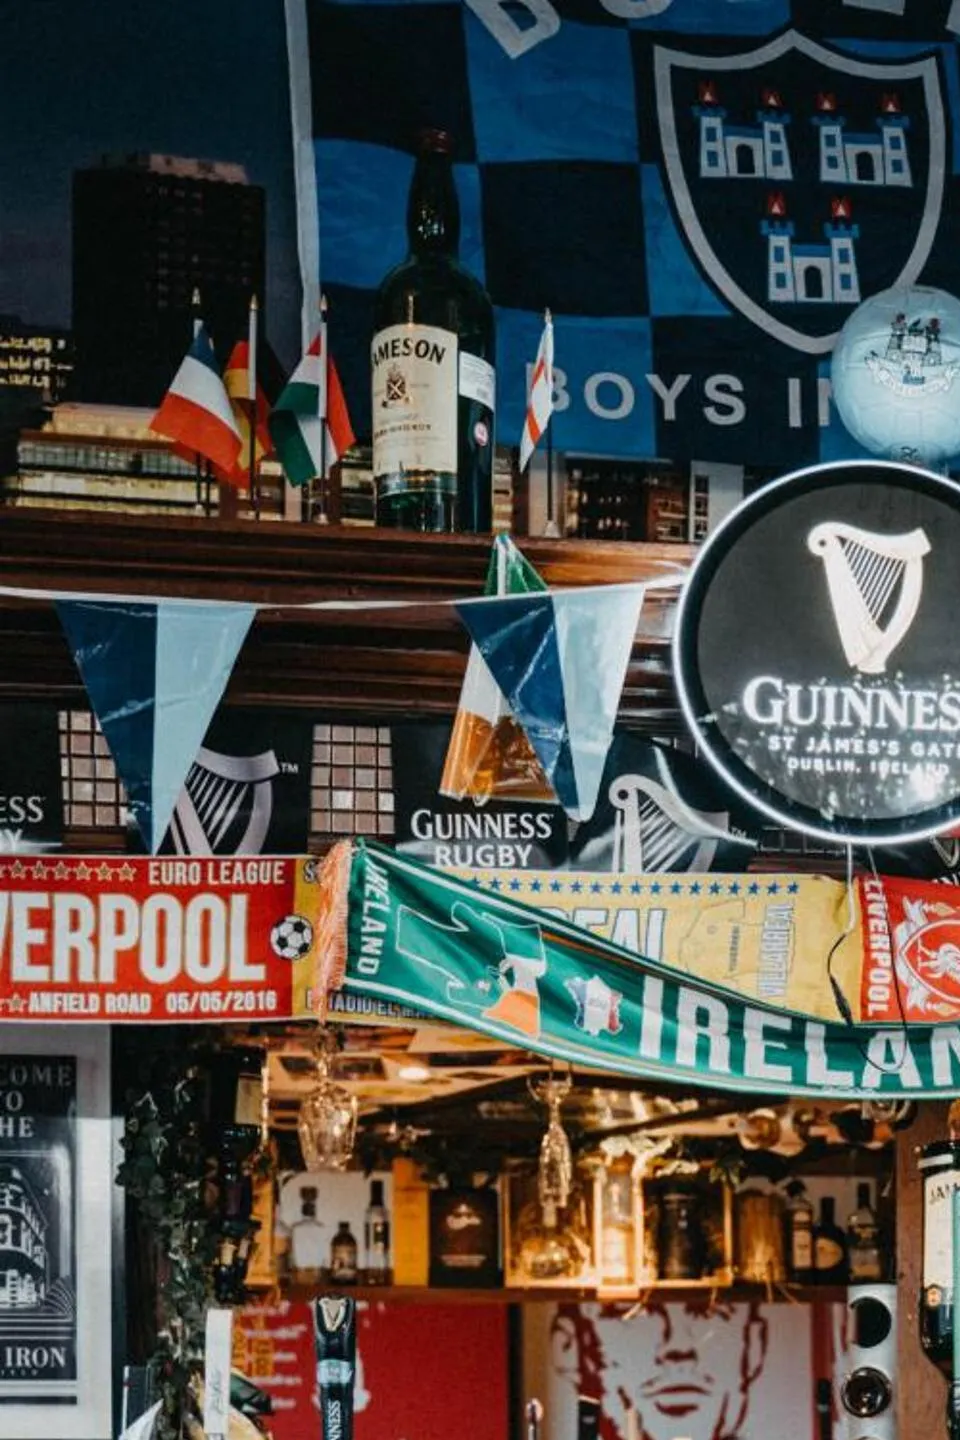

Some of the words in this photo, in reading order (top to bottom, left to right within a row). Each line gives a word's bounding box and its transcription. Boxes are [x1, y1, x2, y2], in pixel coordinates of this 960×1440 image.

[768, 735, 795, 751] ST
[806, 736, 900, 756] JAMES'S
[410, 808, 553, 841] GUINNESS
[435, 843, 532, 868] RUGBY
[149, 861, 202, 886] EURO
[208, 861, 286, 886] LEAGUE
[356, 863, 391, 976] IRELAND
[863, 876, 893, 1018] LIVERPOOL
[28, 991, 100, 1014] ANFIELD
[105, 992, 151, 1014] ROAD
[6, 1346, 66, 1368] IRON
